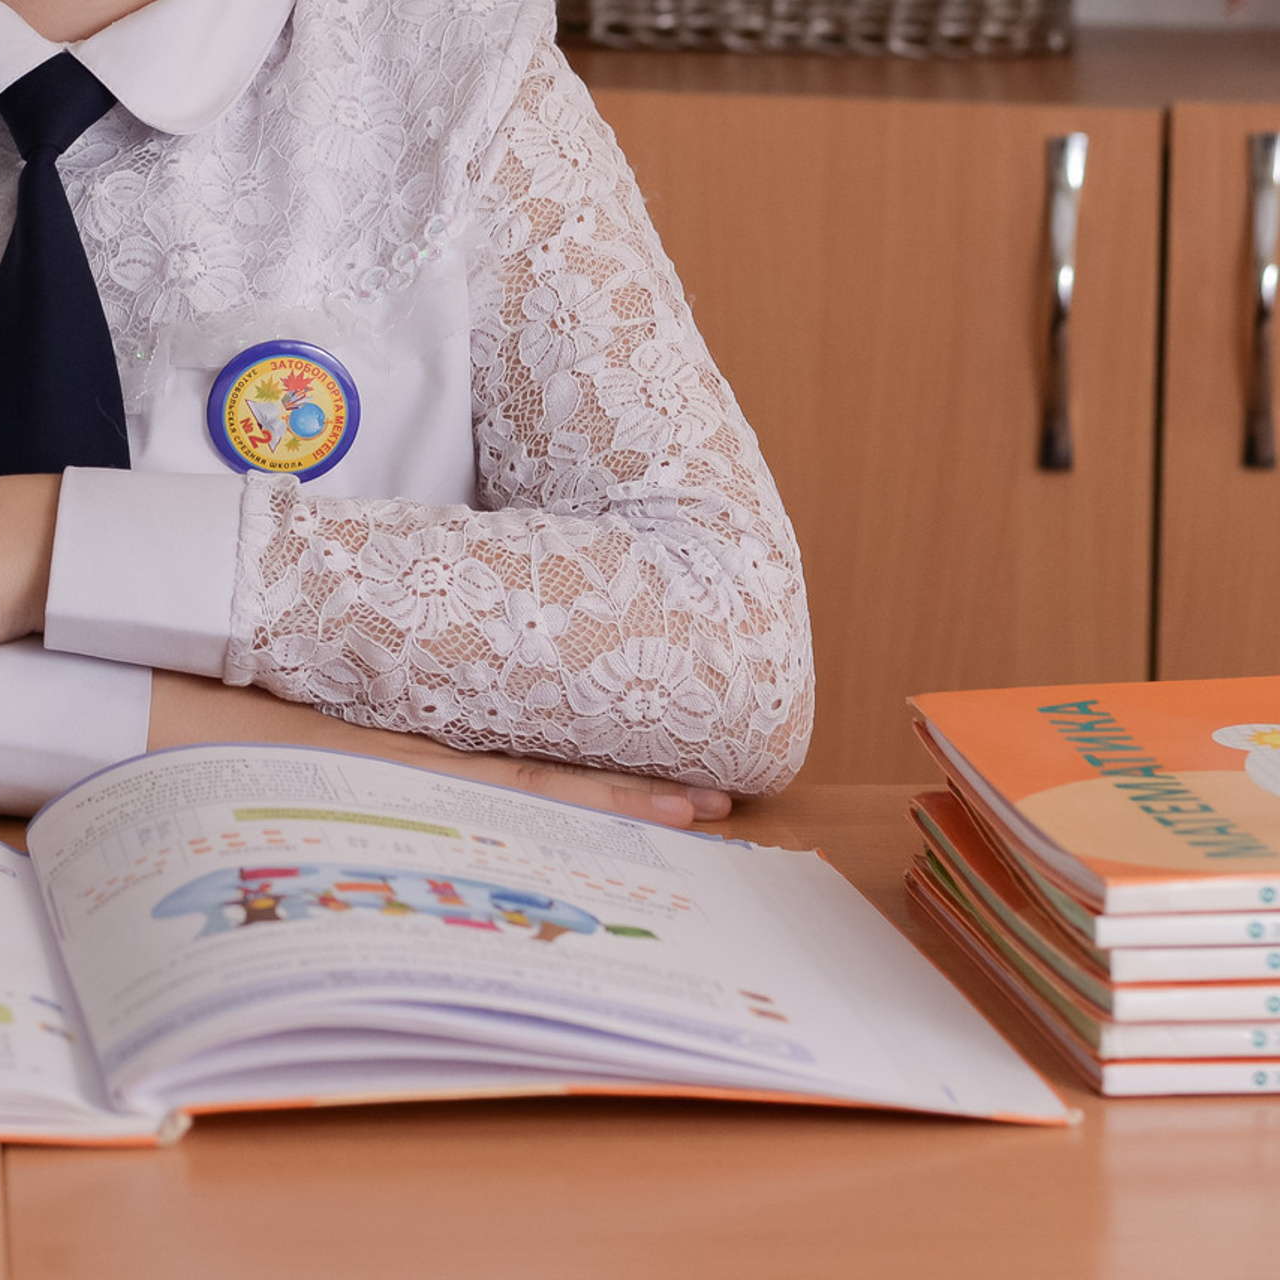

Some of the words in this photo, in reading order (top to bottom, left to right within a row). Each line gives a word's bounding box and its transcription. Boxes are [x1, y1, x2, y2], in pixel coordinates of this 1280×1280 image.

[271, 359, 328, 383] ЗАТОБОЛ
[228, 369, 258, 433] ЗАТОБОЛЬСКАЯ
[326, 378, 344, 412] ОРТА
[235, 435, 267, 466] СРЕДНЯЯ
[312, 416, 345, 461] МЕКТЕБІ
[269, 461, 304, 470] ШКОЛА
[1037, 699, 1277, 859] МАТЕМАТИКА
